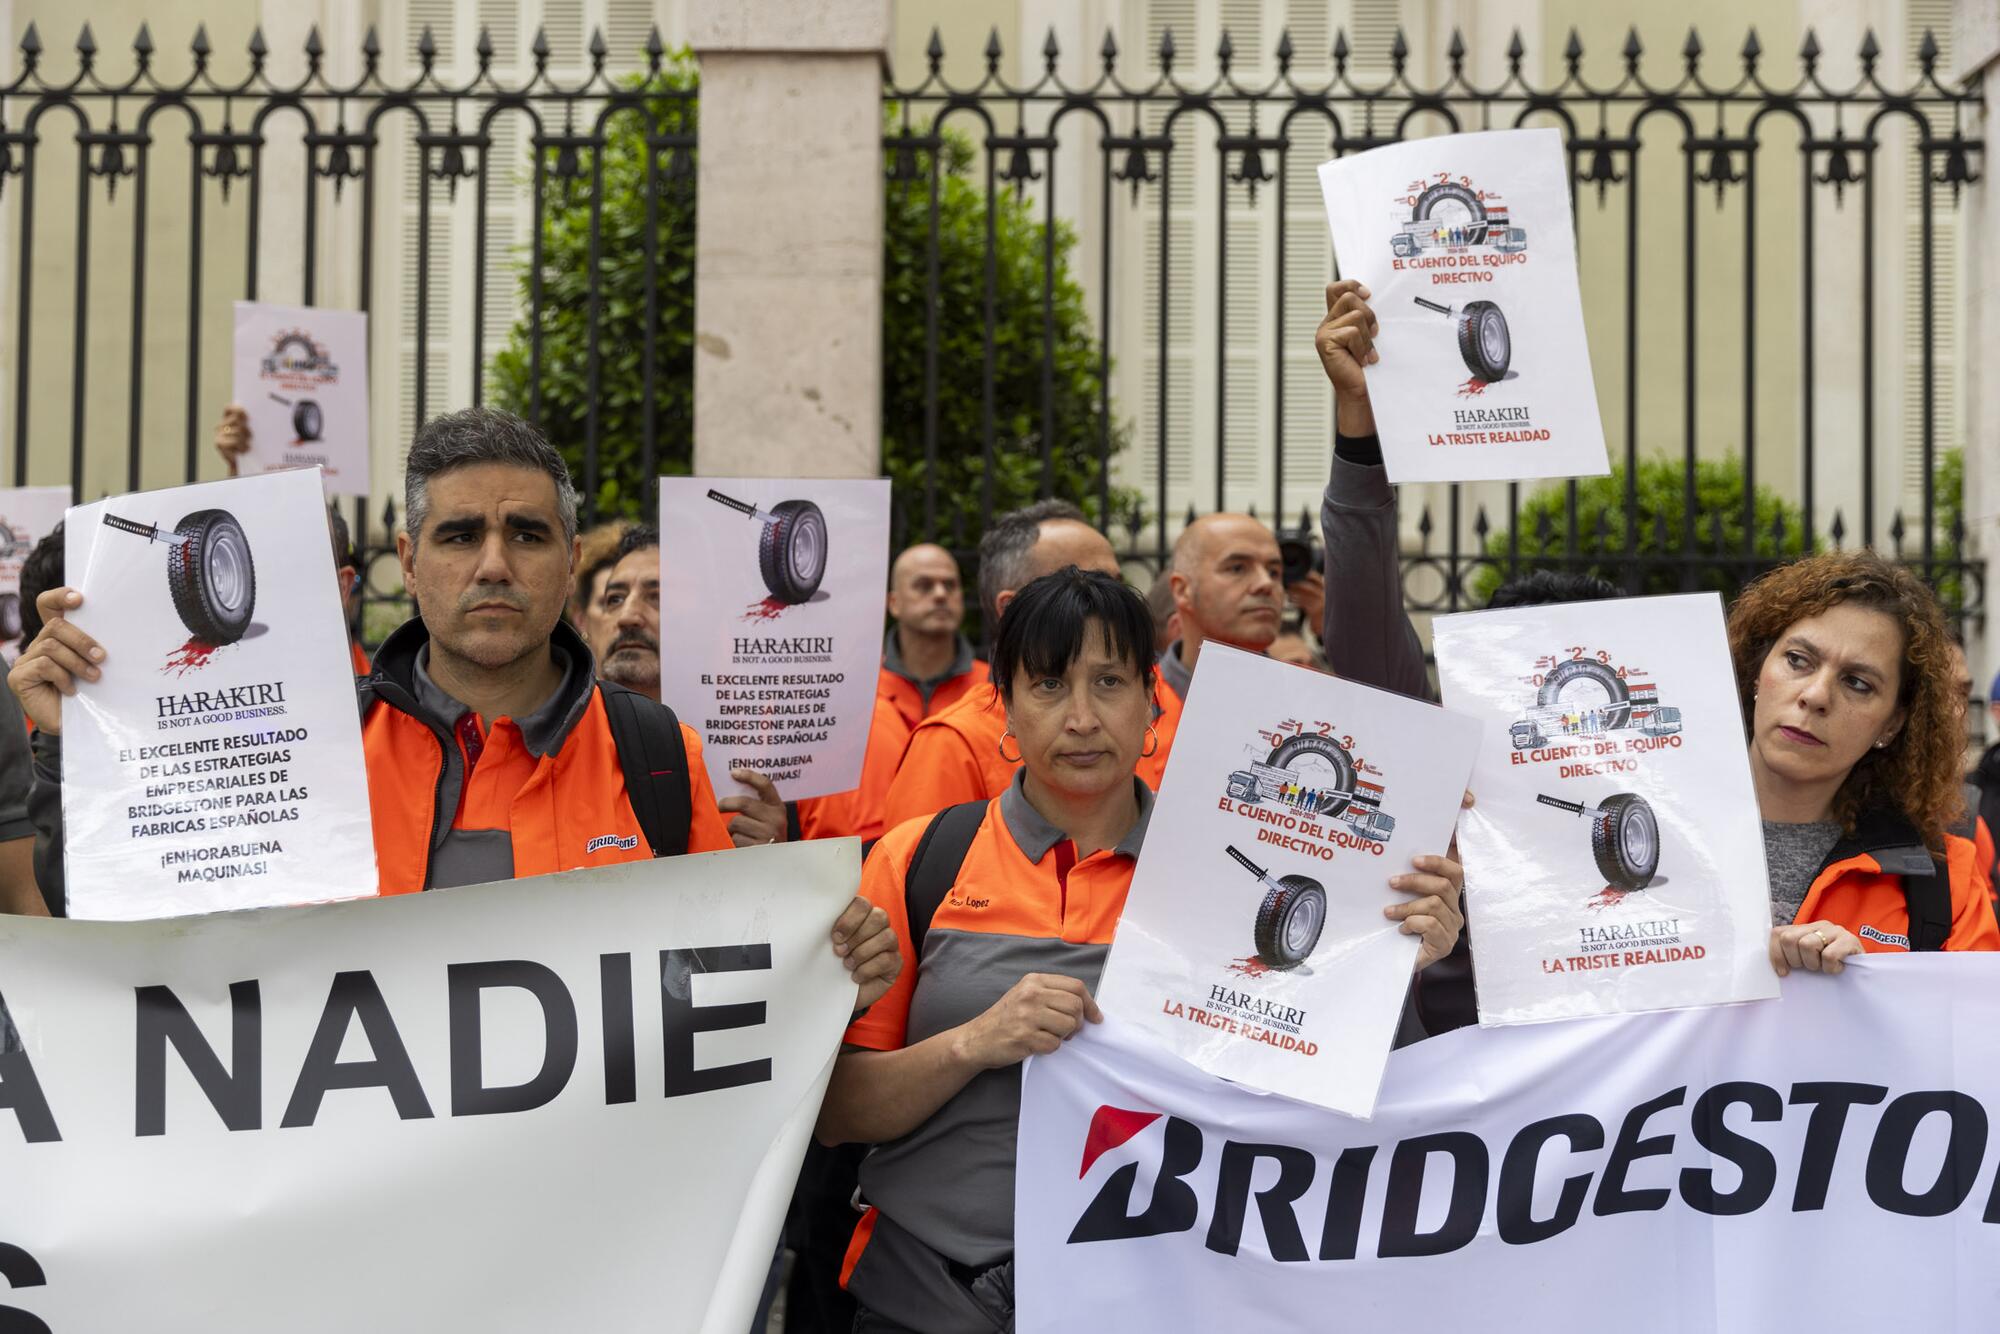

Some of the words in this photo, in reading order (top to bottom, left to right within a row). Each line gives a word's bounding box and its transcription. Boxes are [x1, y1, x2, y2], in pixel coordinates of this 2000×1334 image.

[1407, 195, 1418, 207] 0
[1420, 180, 1428, 192] 1
[1440, 173, 1449, 184] 2
[1460, 176, 1470, 188] 3
[1477, 190, 1485, 201] 4
[1393, 259, 1406, 270] EL
[1409, 256, 1456, 269] CUENTO
[1460, 256, 1480, 267] DEL
[1483, 253, 1527, 267] EQUIPO
[1432, 271, 1493, 285] DIRECTIVO
[1454, 407, 1530, 423] HARAKIRI
[1428, 434, 1446, 446] LA
[1446, 432, 1487, 445] TRISTE
[1489, 429, 1551, 443] REALIDAD
[732, 656, 741, 664] IS
[742, 656, 759, 664] NOT
[761, 656, 767, 664] A
[768, 656, 792, 664] GOOD
[733, 637, 834, 655] HARAKIRI
[701, 675, 713, 685] EL
[717, 675, 779, 685] EXCELENTE
[782, 673, 845, 685] RESULTADO
[1532, 674, 1545, 687] 0
[1548, 656, 1558, 669] 1
[1572, 647, 1584, 660] 2
[1596, 650, 1608, 664] 3
[1616, 666, 1628, 679] 4
[156, 682, 286, 718] HARAKIRI
[716, 690, 730, 700] DE
[733, 690, 756, 700] LAS
[758, 688, 830, 700] ESTRATEGIAS
[157, 720, 168, 730] IS
[170, 717, 192, 729] NOT
[193, 717, 201, 725] A
[202, 712, 233, 724] GOOD
[235, 705, 288, 720] BUSINESS.
[705, 720, 785, 730] BRIDGESTONE
[787, 719, 815, 729] PARA
[817, 716, 836, 727] LAS
[720, 704, 811, 715] EMPRESARIALES
[813, 703, 826, 713] DE
[119, 750, 136, 762] EL
[139, 739, 219, 760] EXCELENTE
[223, 727, 308, 750] RESULTADO
[708, 734, 764, 745] FABRICAS
[767, 731, 828, 745] ESPAÑOLAS
[1271, 733, 1283, 748] 0
[1295, 722, 1303, 736] 1
[1318, 722, 1331, 737] 2
[1340, 736, 1353, 750] 3
[1352, 758, 1365, 772] 4
[1511, 752, 1528, 765] EL
[1530, 746, 1591, 763] CUENTO
[1594, 742, 1622, 755] DEL
[1625, 735, 1682, 753] EQUIPO
[140, 765, 158, 779] DE
[162, 762, 191, 777] LAS
[195, 749, 292, 773] ESTRATEGIAS
[728, 754, 813, 771] ¡ENHORABUENA
[1560, 759, 1638, 779] DIRECTIVO
[146, 773, 266, 798] EMPRESARIALES
[270, 769, 288, 784] DE
[128, 796, 232, 819] BRIDGESTONE
[236, 791, 274, 807] PARA
[280, 787, 308, 801] LAS
[131, 818, 206, 838] FABRICAS
[210, 807, 299, 829] ESPAÑOLAS
[1218, 797, 1233, 812] EL
[1237, 803, 1296, 829] CUENTO
[1298, 821, 1324, 839] DEL
[1328, 830, 1385, 855] EQUIPO
[161, 840, 283, 868] ¡ENHORABUENA
[1257, 829, 1333, 861] DIRECTIVO
[177, 861, 268, 883] MAQUINAS!
[966, 896, 990, 909] Lopez
[1579, 919, 1681, 943] HARAKIRI
[1590, 944, 1608, 952] NOT
[1616, 940, 1639, 949] GOOD
[1641, 936, 1682, 947] BUSINESS.
[1542, 959, 1565, 974] LA
[1566, 953, 1620, 972] TRISTE
[1624, 945, 1706, 966] REALIDAD
[1209, 984, 1307, 1026] HARAKIRI
[1163, 999, 1184, 1018] LA
[1188, 1007, 1238, 1034] TRISTE
[1240, 1024, 1319, 1057] REALIDAD
[1214, 1004, 1232, 1014] NOT
[1232, 1009, 1238, 1017] A
[1239, 1011, 1262, 1023] GOOD
[1263, 1017, 1301, 1035] BUSINESS.
[135, 942, 773, 1137] NADIE
[1066, 1081, 2000, 1263] BRIDGESTO
